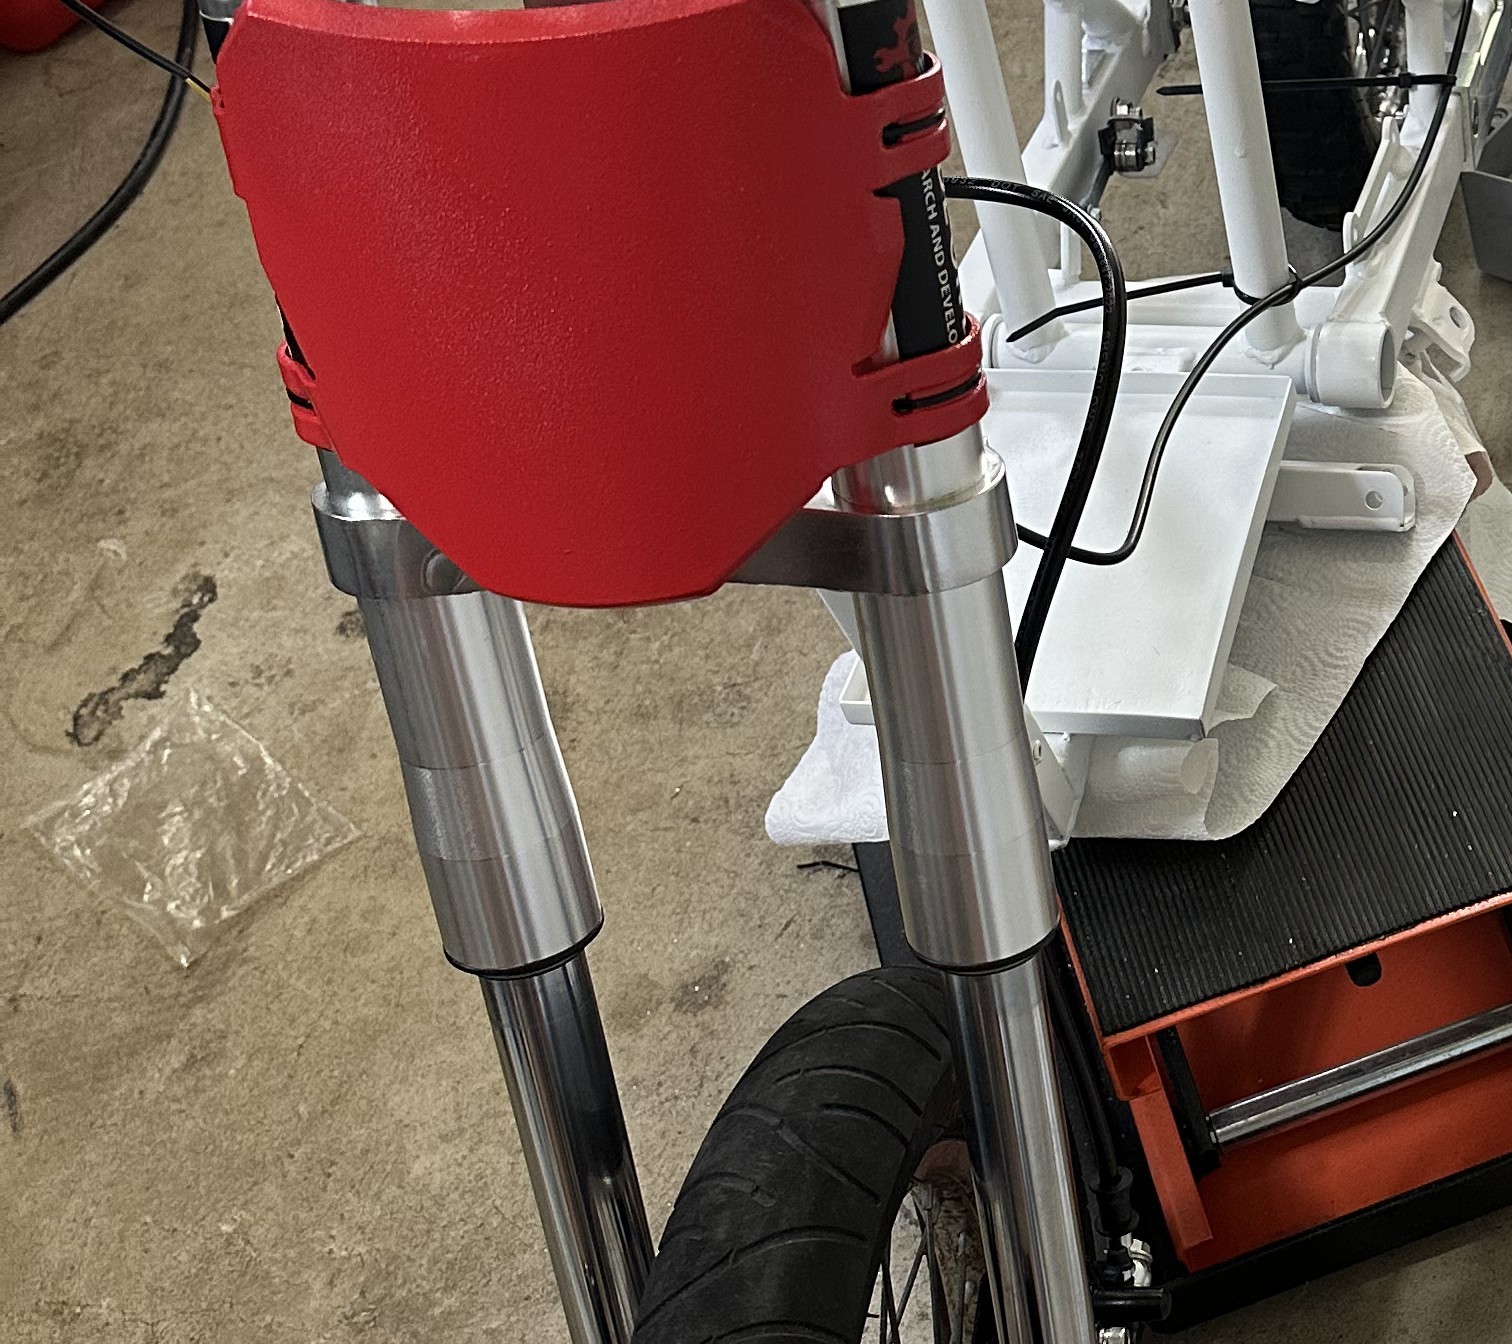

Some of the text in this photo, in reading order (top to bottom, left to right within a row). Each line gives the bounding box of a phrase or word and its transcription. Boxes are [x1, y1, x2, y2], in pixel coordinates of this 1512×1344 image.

[990, 179, 1019, 191] DOT
[930, 224, 946, 267] AND
[937, 269, 959, 344] DEVELO
